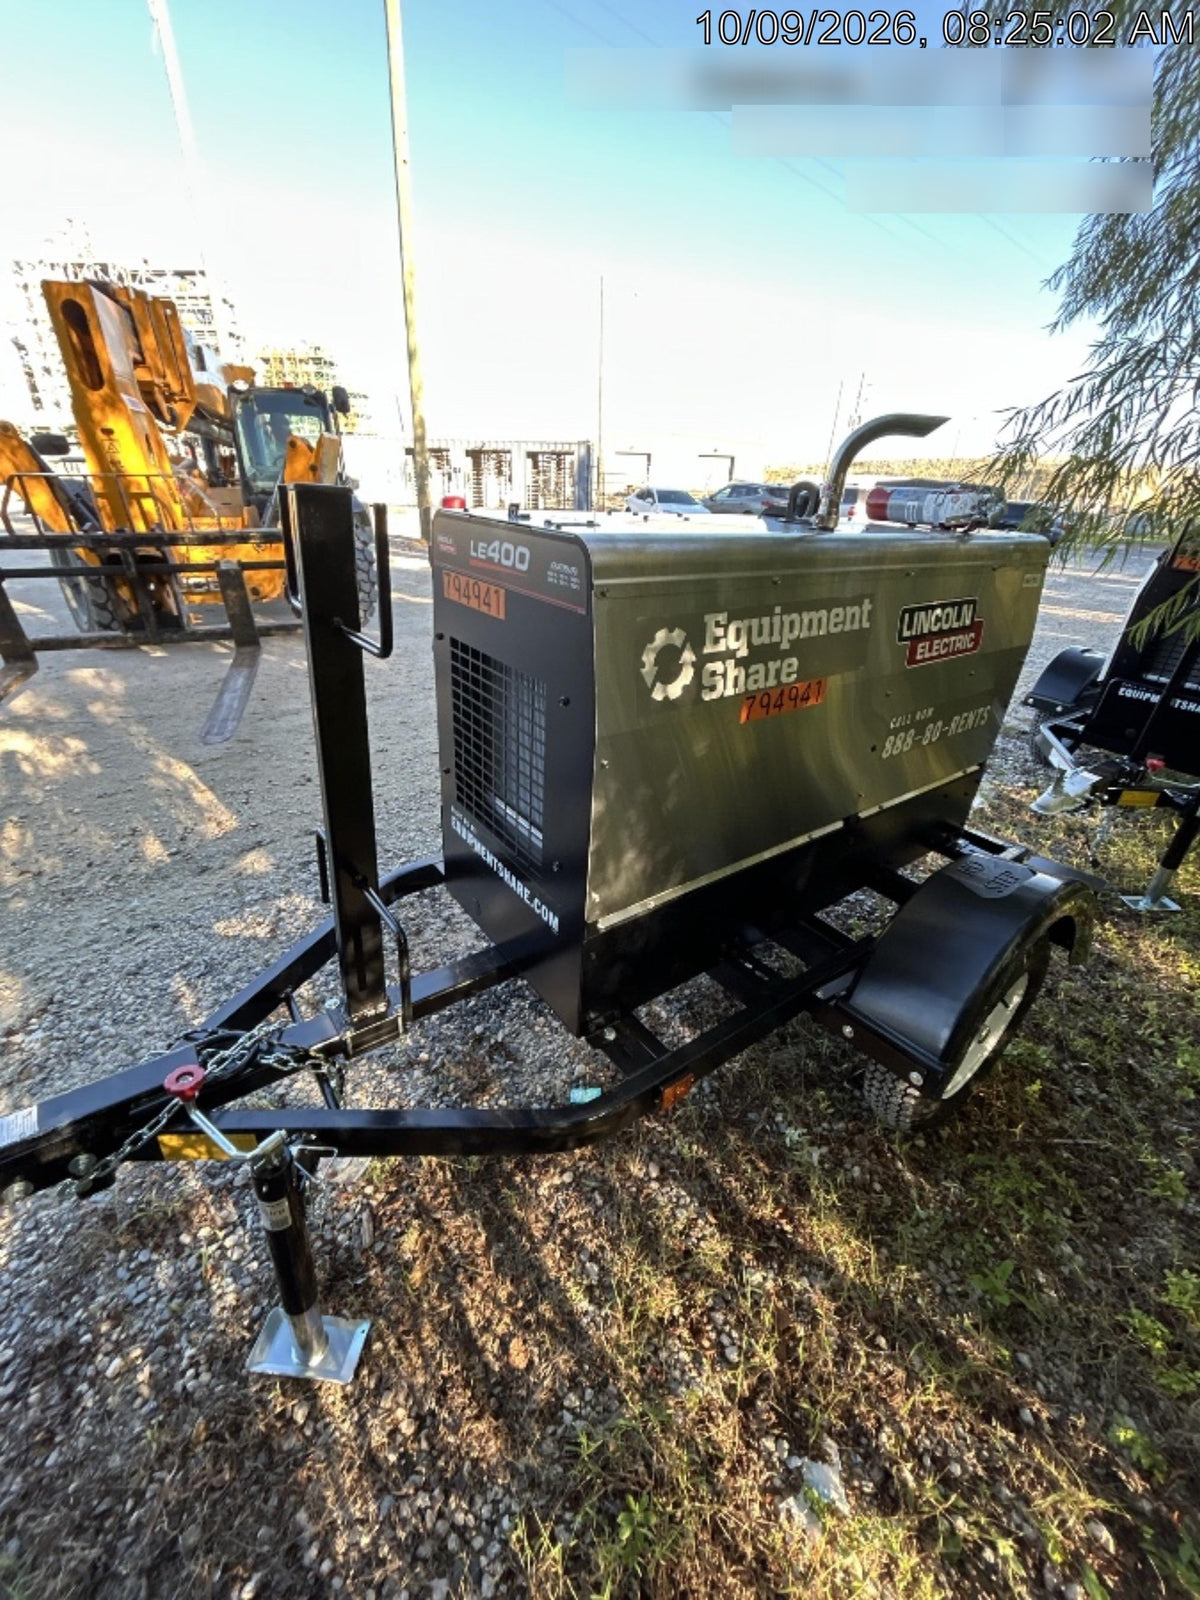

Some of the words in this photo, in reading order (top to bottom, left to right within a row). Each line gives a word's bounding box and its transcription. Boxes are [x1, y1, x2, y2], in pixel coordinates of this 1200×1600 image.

[469, 540, 531, 571] LE400
[444, 571, 503, 617] 794941
[702, 598, 872, 658] Equipment
[902, 603, 974, 637] LINCOLN
[915, 631, 977, 660] ELECTRIC
[701, 656, 799, 701] Share
[745, 679, 823, 721] 794941
[881, 704, 991, 760] 888-80-RENTS
